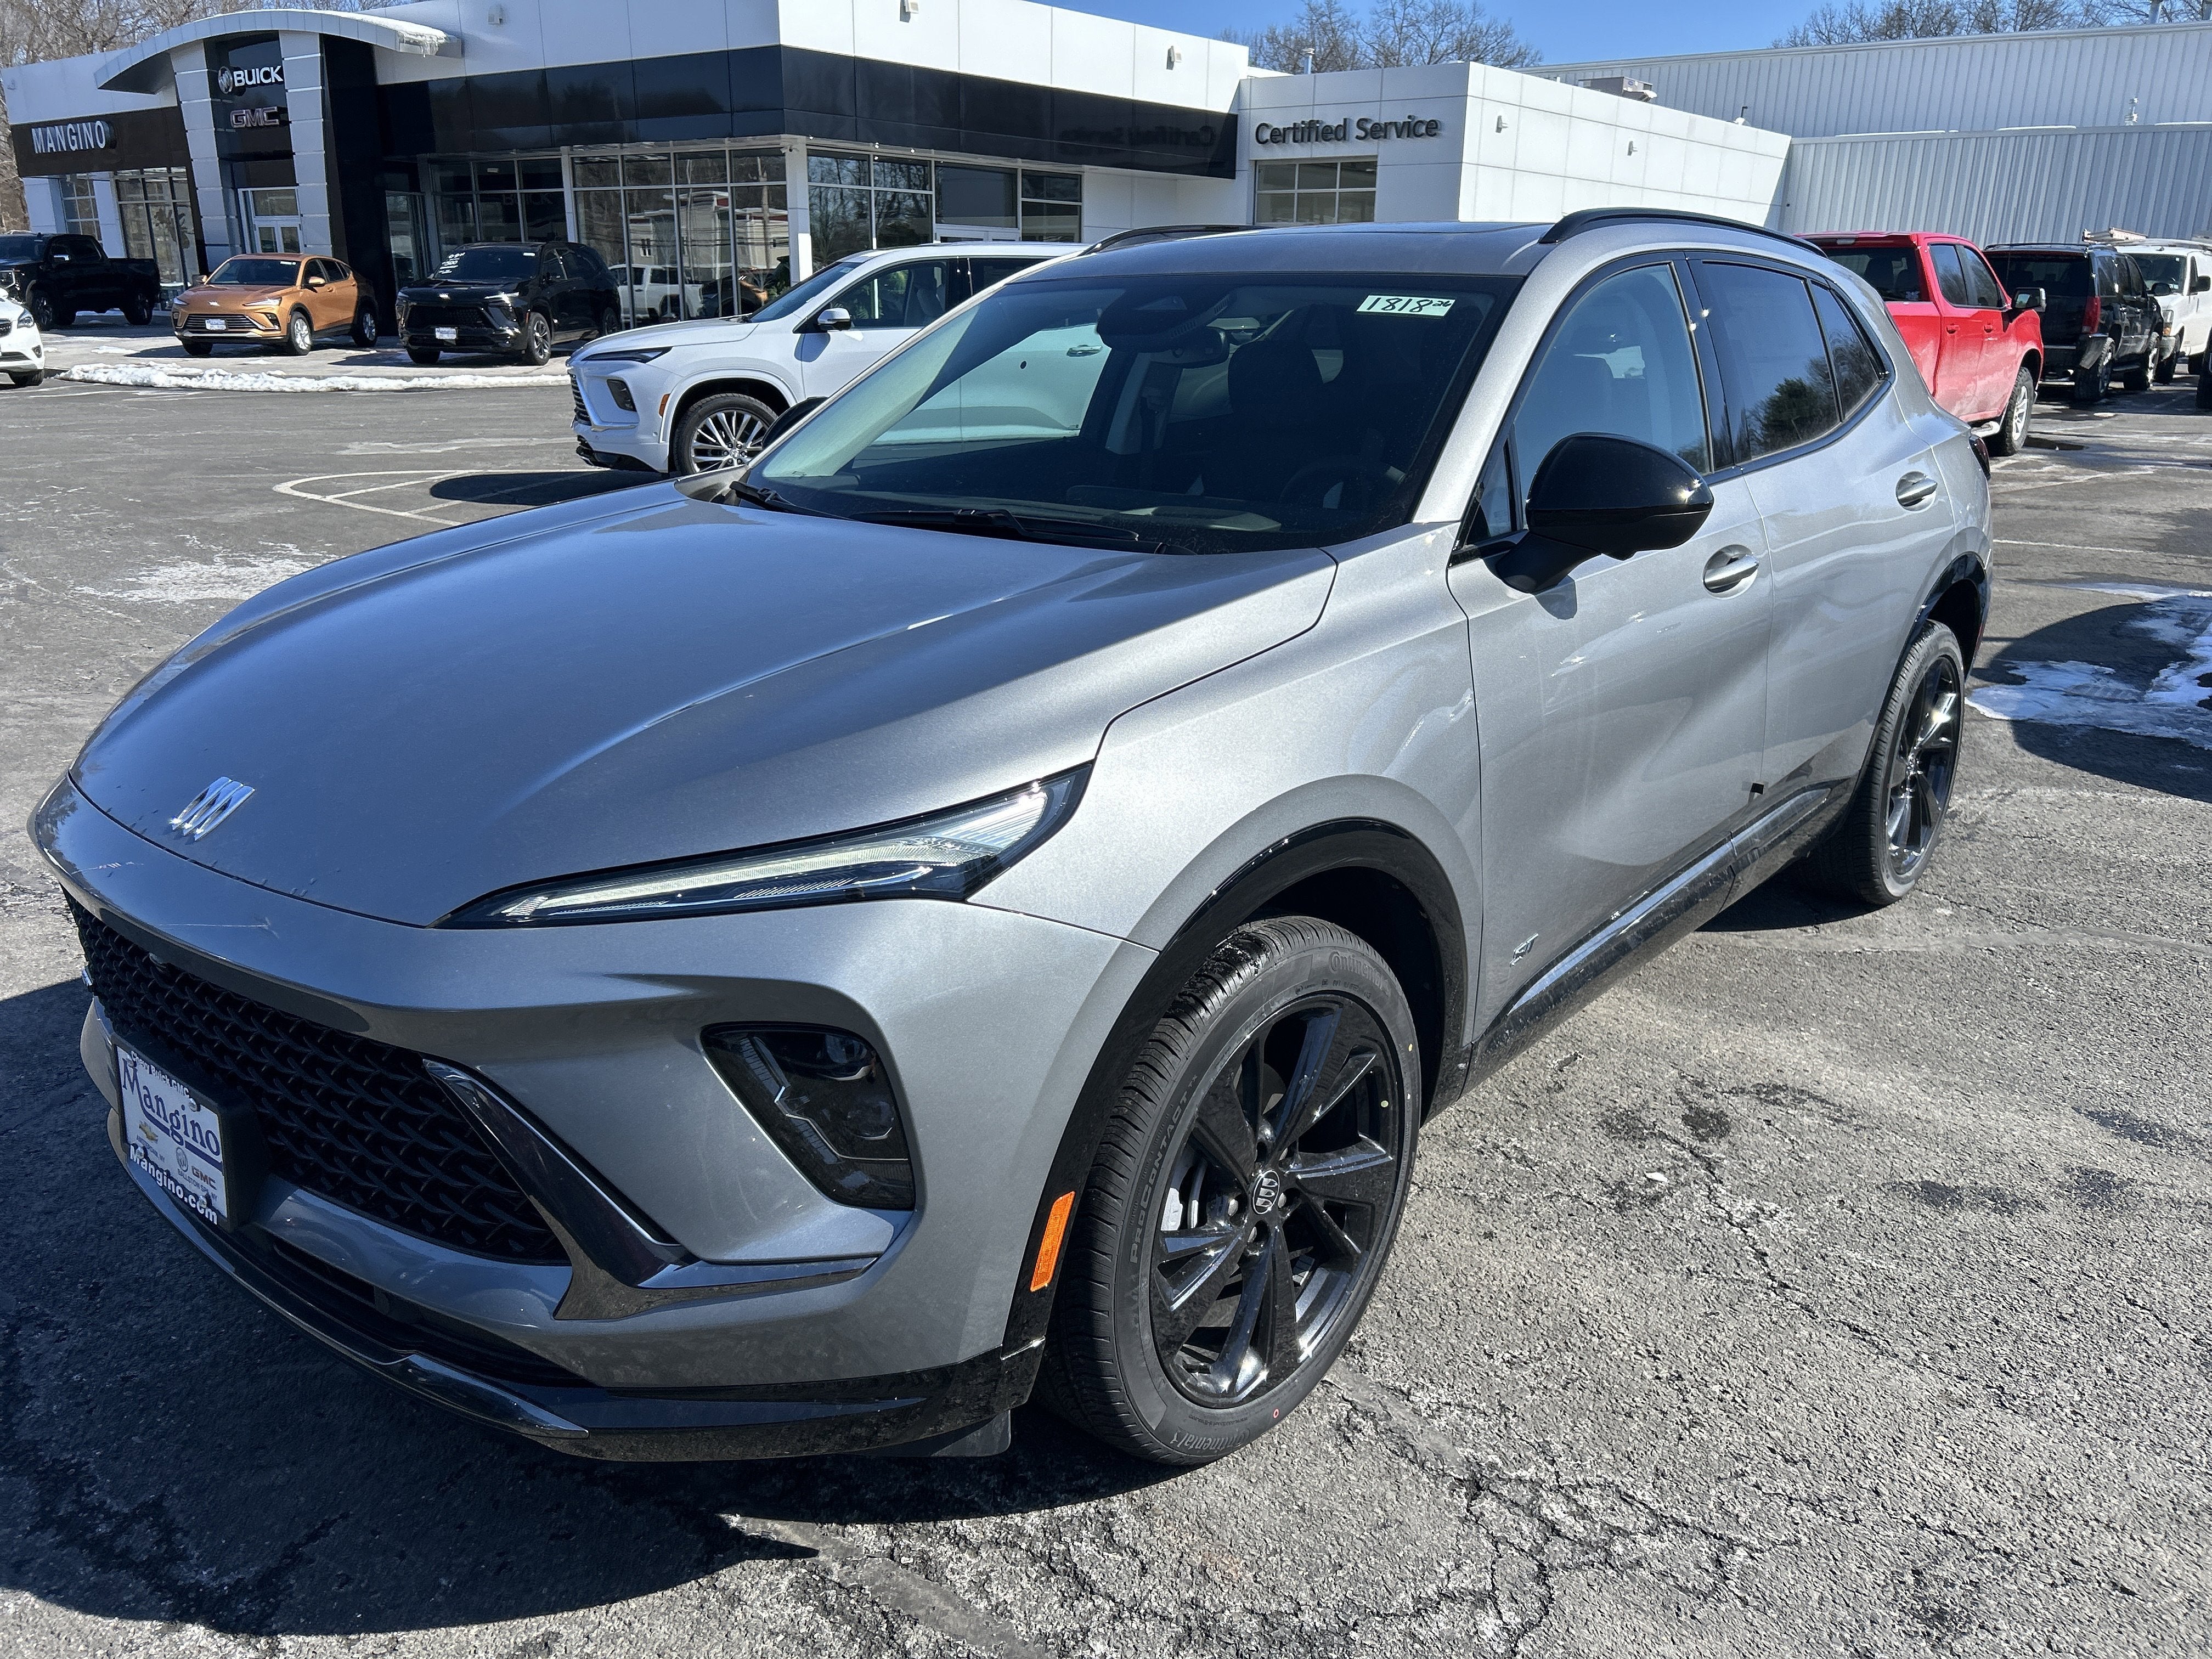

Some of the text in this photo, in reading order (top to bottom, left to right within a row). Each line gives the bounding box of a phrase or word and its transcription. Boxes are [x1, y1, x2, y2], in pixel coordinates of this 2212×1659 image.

[233, 65, 284, 87] BUICK
[230, 106, 279, 128] GMC
[31, 120, 106, 154] MANGINO
[1255, 115, 1441, 144] Certified Service
[1367, 297, 1433, 313] 1818
[122, 1058, 221, 1156] Mangino
[192, 1166, 217, 1190] GMC
